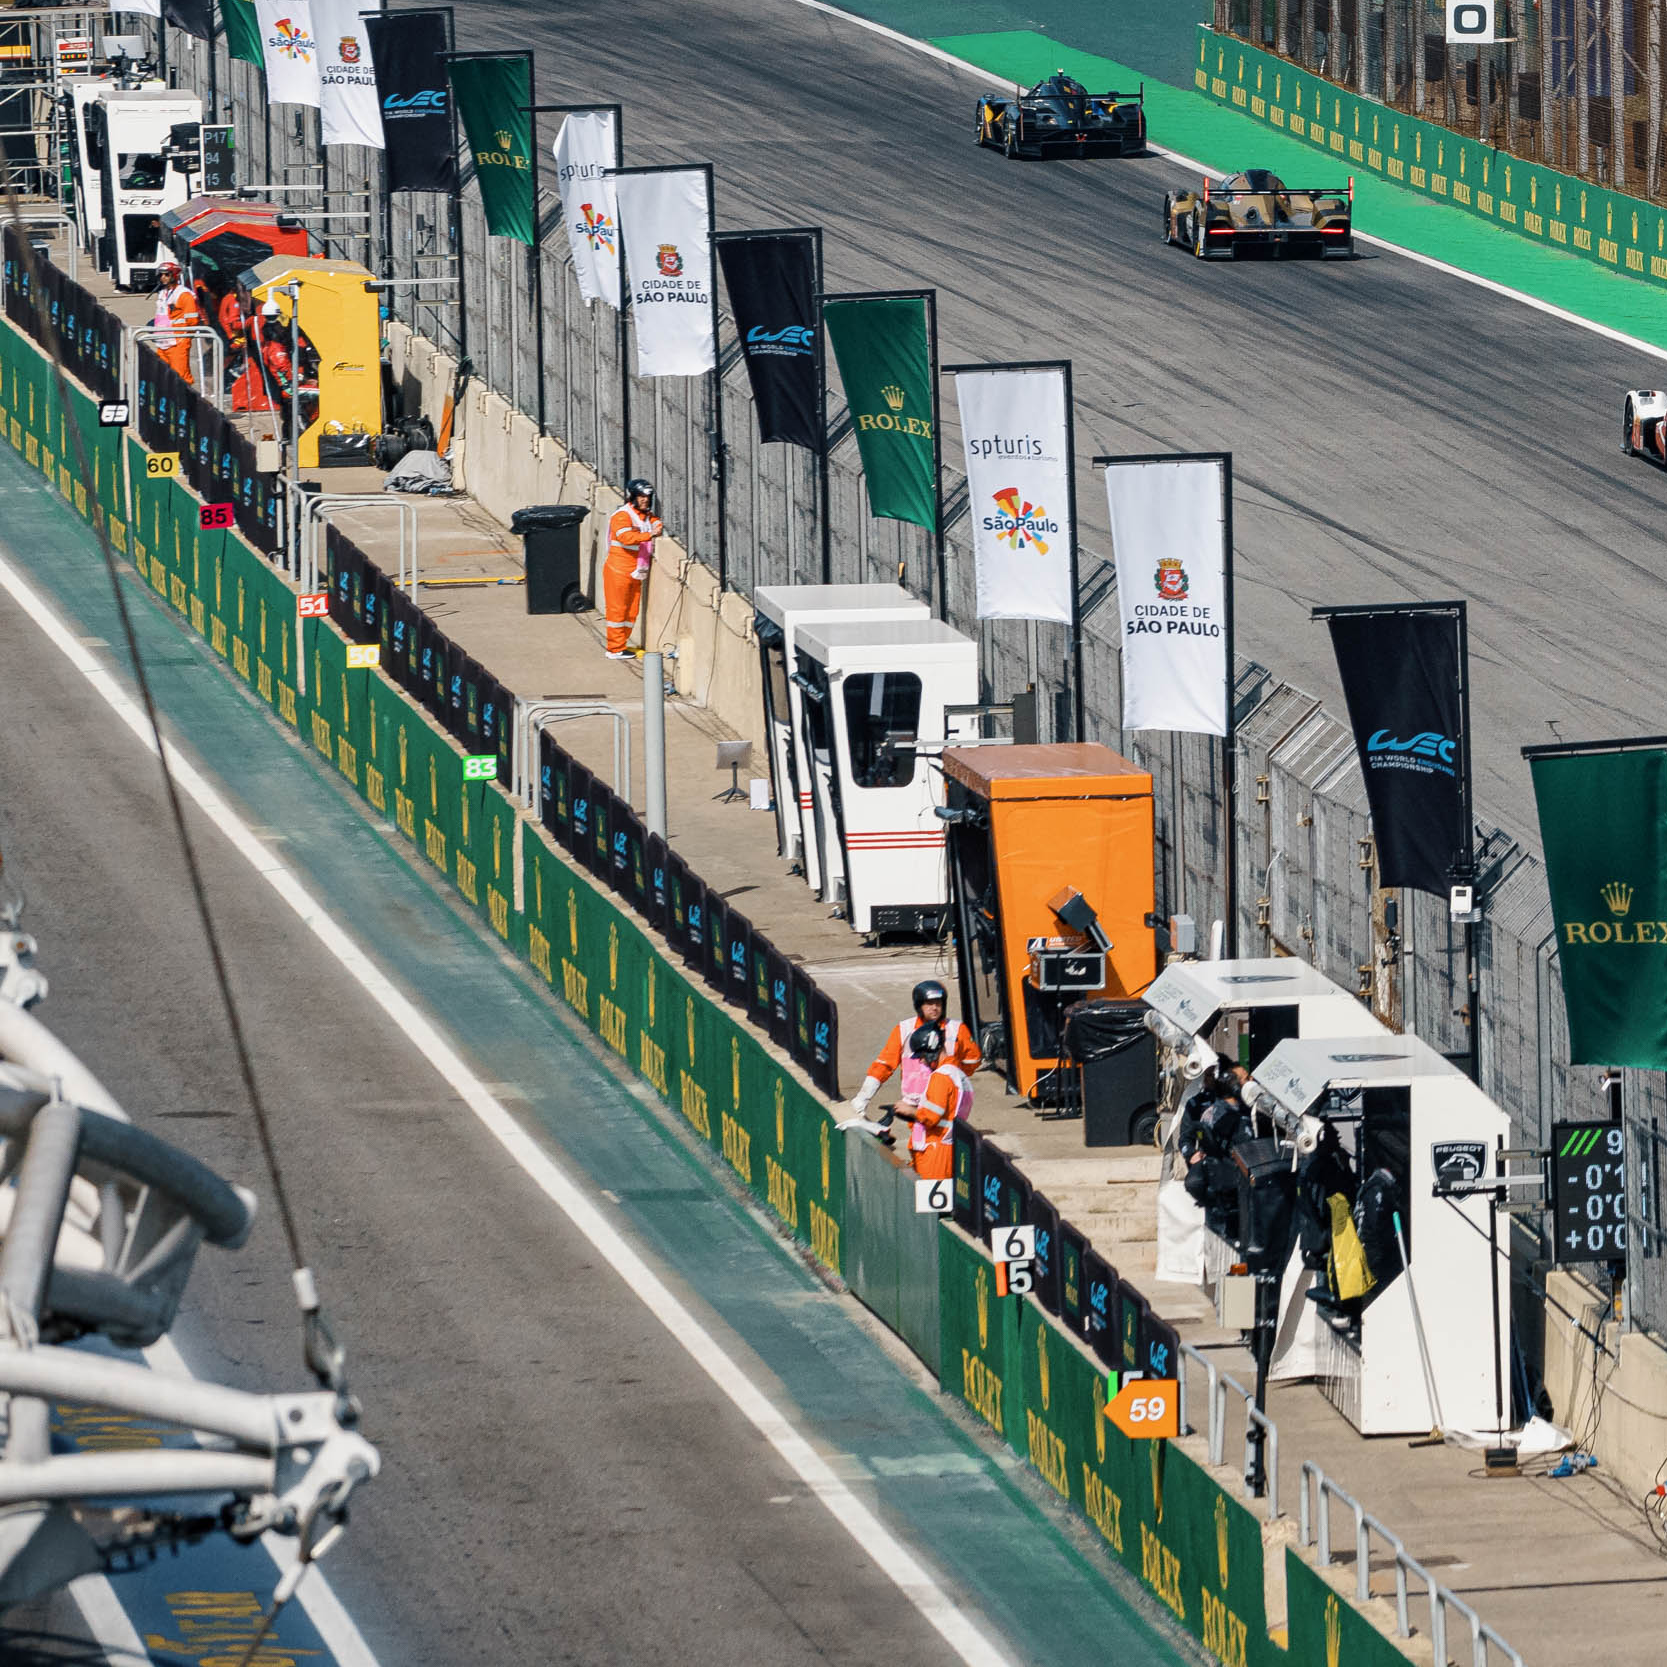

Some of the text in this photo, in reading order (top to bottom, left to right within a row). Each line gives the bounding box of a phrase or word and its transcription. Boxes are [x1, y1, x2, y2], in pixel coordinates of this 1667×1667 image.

[326, 65, 361, 74] CIDADE
[321, 73, 377, 86] SÃO PAUL
[384, 90, 446, 108] WEC
[642, 280, 701, 290] CIDADE DE
[636, 290, 708, 304] SÃO PAULO
[747, 325, 814, 346] WEC
[858, 413, 934, 439] ROLEX
[970, 434, 1042, 461] spturis
[147, 457, 173, 473] 60
[200, 508, 227, 526] 85
[983, 516, 1058, 533] SãoPaulo
[300, 598, 329, 615] 51
[1134, 605, 1210, 619] CIDADE DE
[1127, 617, 1219, 638] SÃO PAULO
[349, 647, 380, 665] 50
[1367, 729, 1456, 763] WEC
[466, 757, 497, 778] 83
[1435, 1144, 1483, 1154] PEUGEOT
[928, 1180, 948, 1209] 6
[1005, 1228, 1025, 1258] 6
[1129, 1397, 1165, 1423] 59
